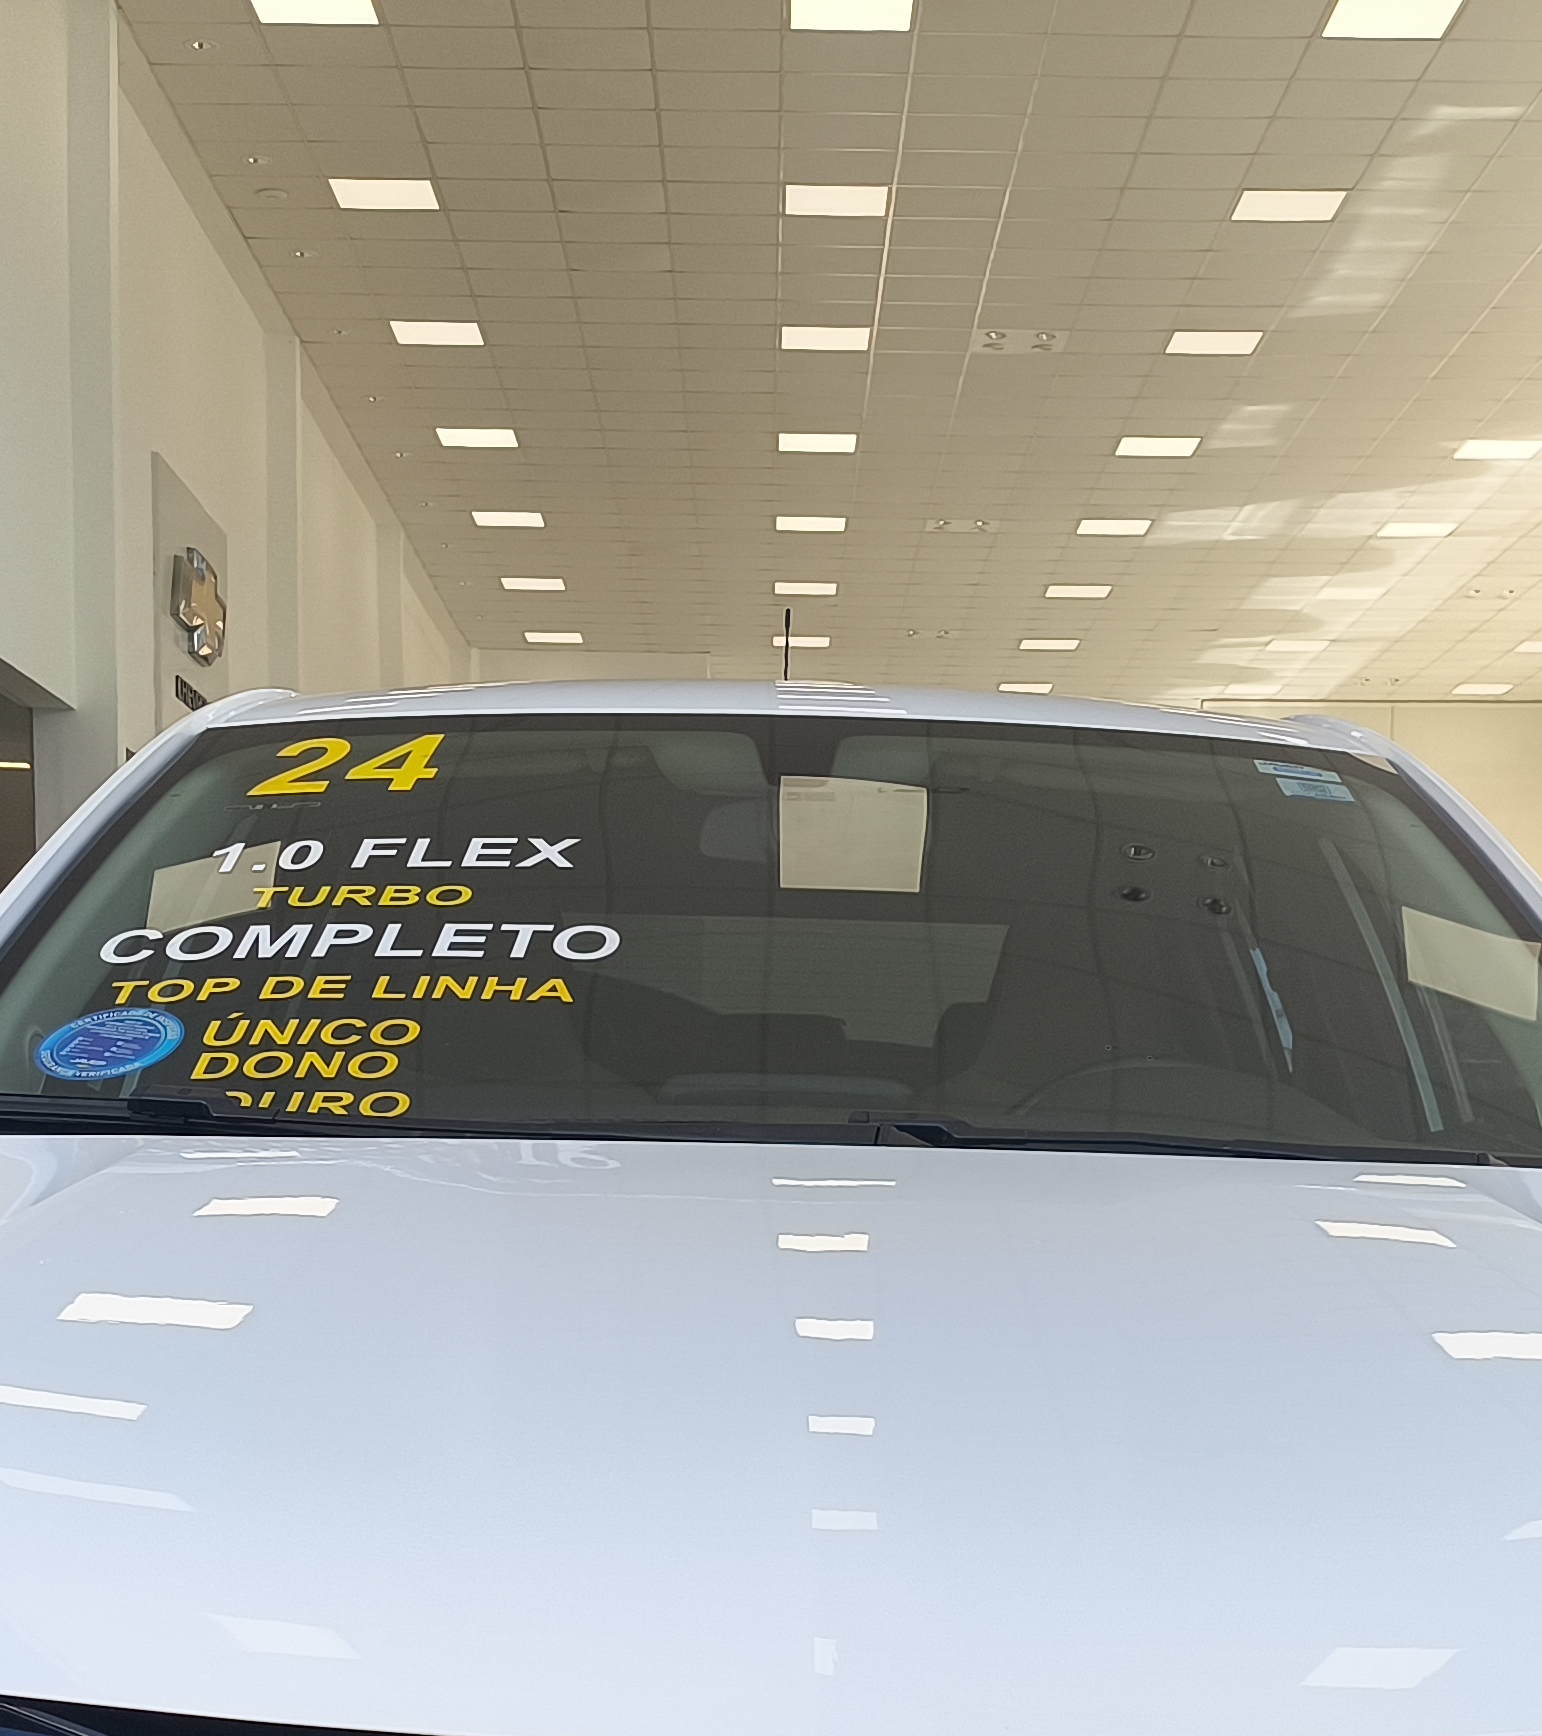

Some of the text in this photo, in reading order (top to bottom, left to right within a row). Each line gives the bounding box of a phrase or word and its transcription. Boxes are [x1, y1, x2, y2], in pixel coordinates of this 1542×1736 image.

[248, 733, 445, 797] 24
[211, 836, 583, 874] 1.0 FLEX
[253, 884, 473, 909] TURBO
[99, 922, 622, 965] COMPLETO
[112, 975, 575, 1005] TOP DE LINHA
[202, 1012, 422, 1047] ÚNICO
[191, 1051, 399, 1081] DONO
